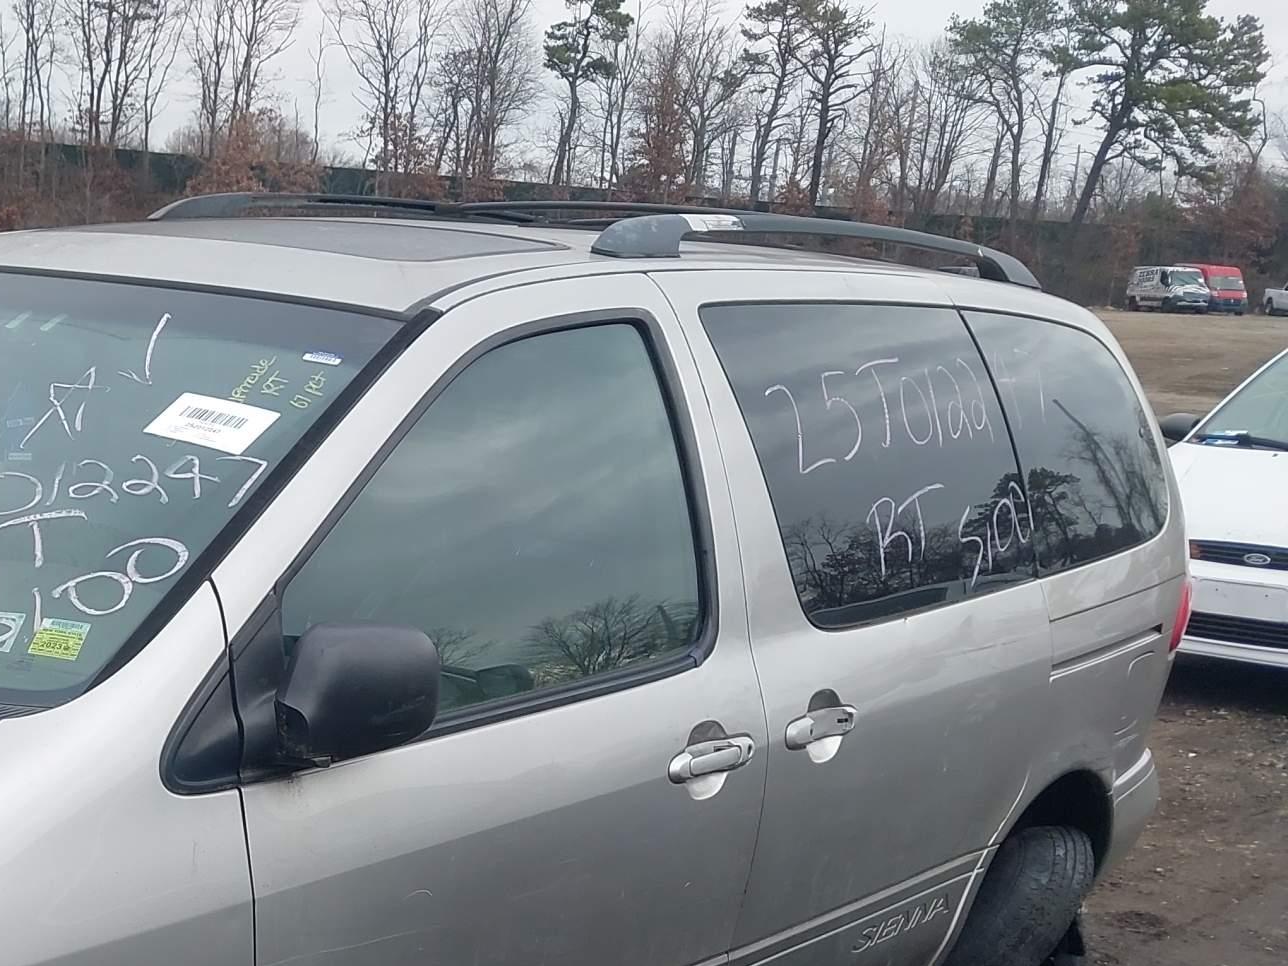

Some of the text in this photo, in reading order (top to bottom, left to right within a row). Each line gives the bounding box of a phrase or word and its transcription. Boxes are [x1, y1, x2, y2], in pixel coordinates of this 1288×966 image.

[261, 370, 289, 396] RT
[40, 640, 62, 650] 2023
[851, 893, 950, 953] SIENNA
